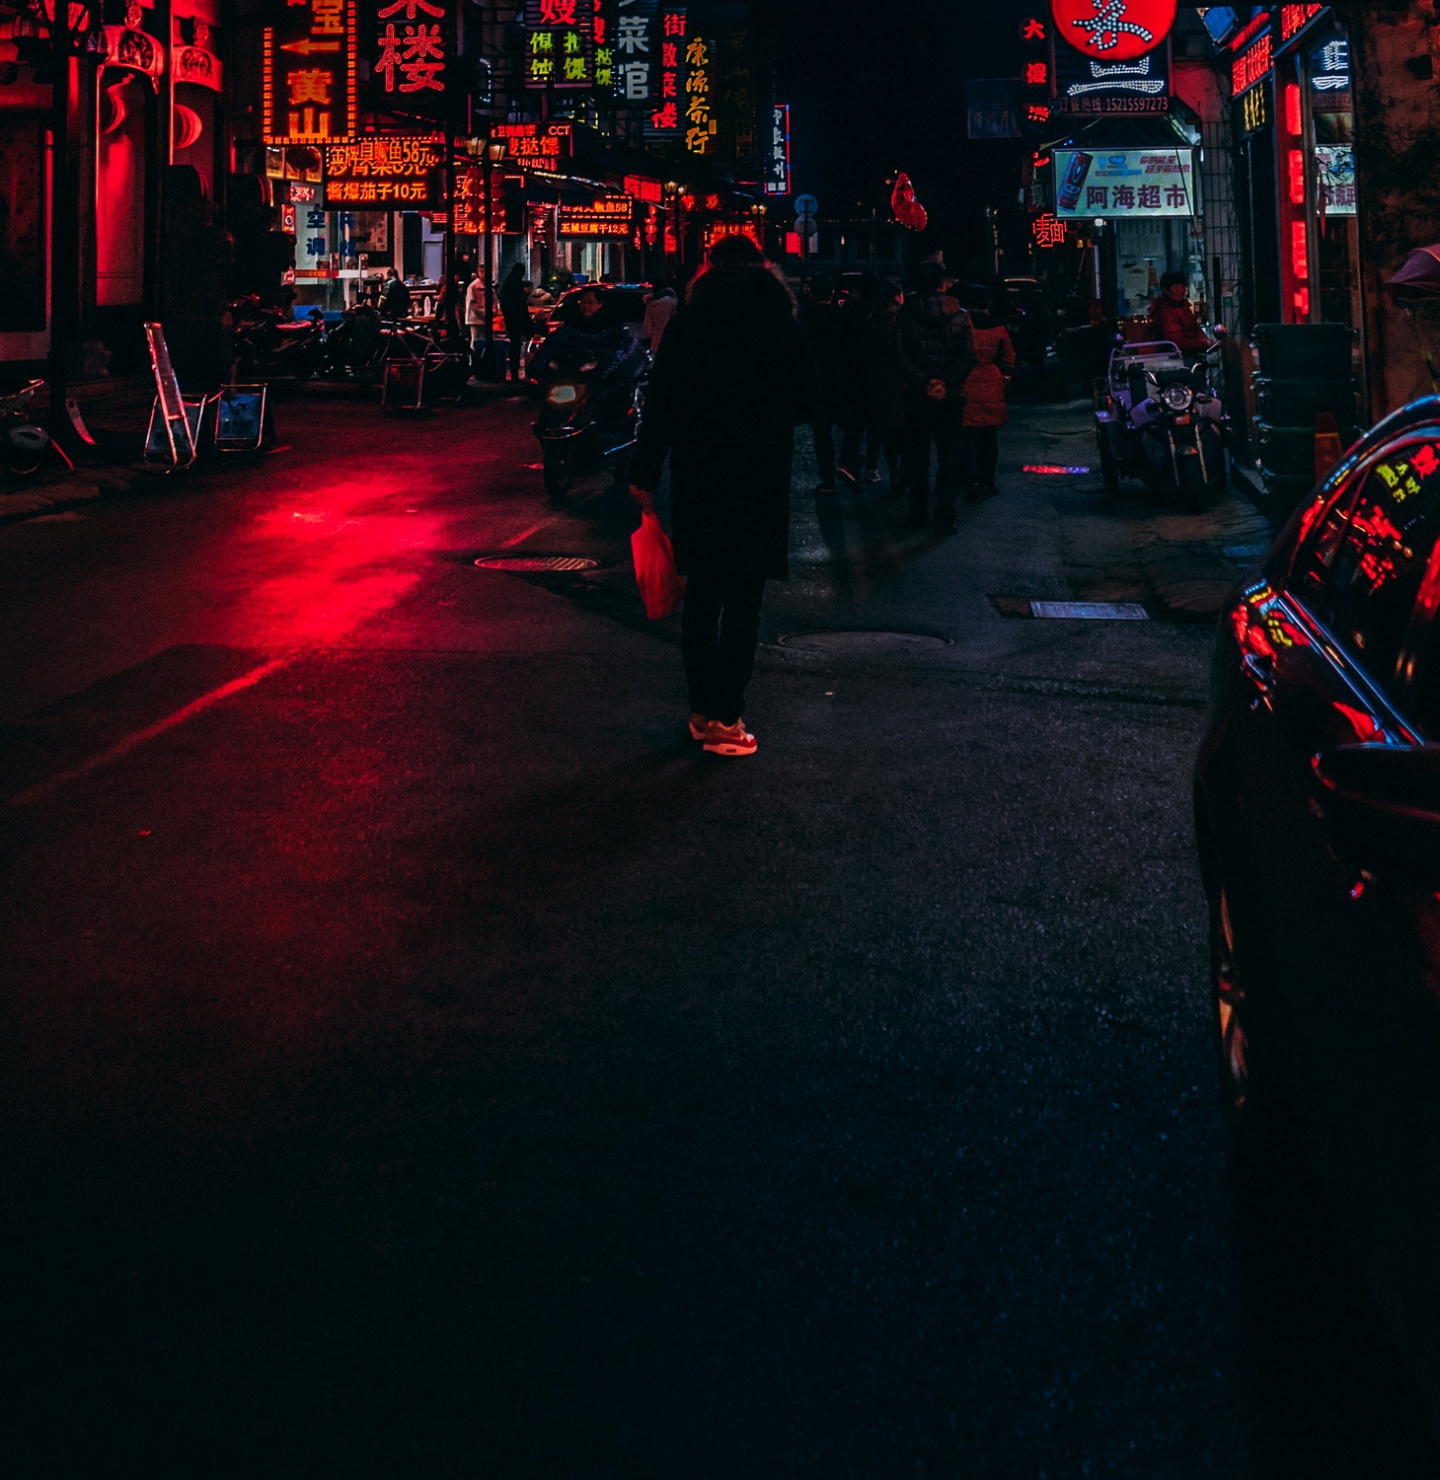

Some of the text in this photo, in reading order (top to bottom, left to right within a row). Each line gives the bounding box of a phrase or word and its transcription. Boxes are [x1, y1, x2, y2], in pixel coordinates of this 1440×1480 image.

[287, 69, 334, 139] 黄山
[1086, 184, 1186, 210] 阿海超市
